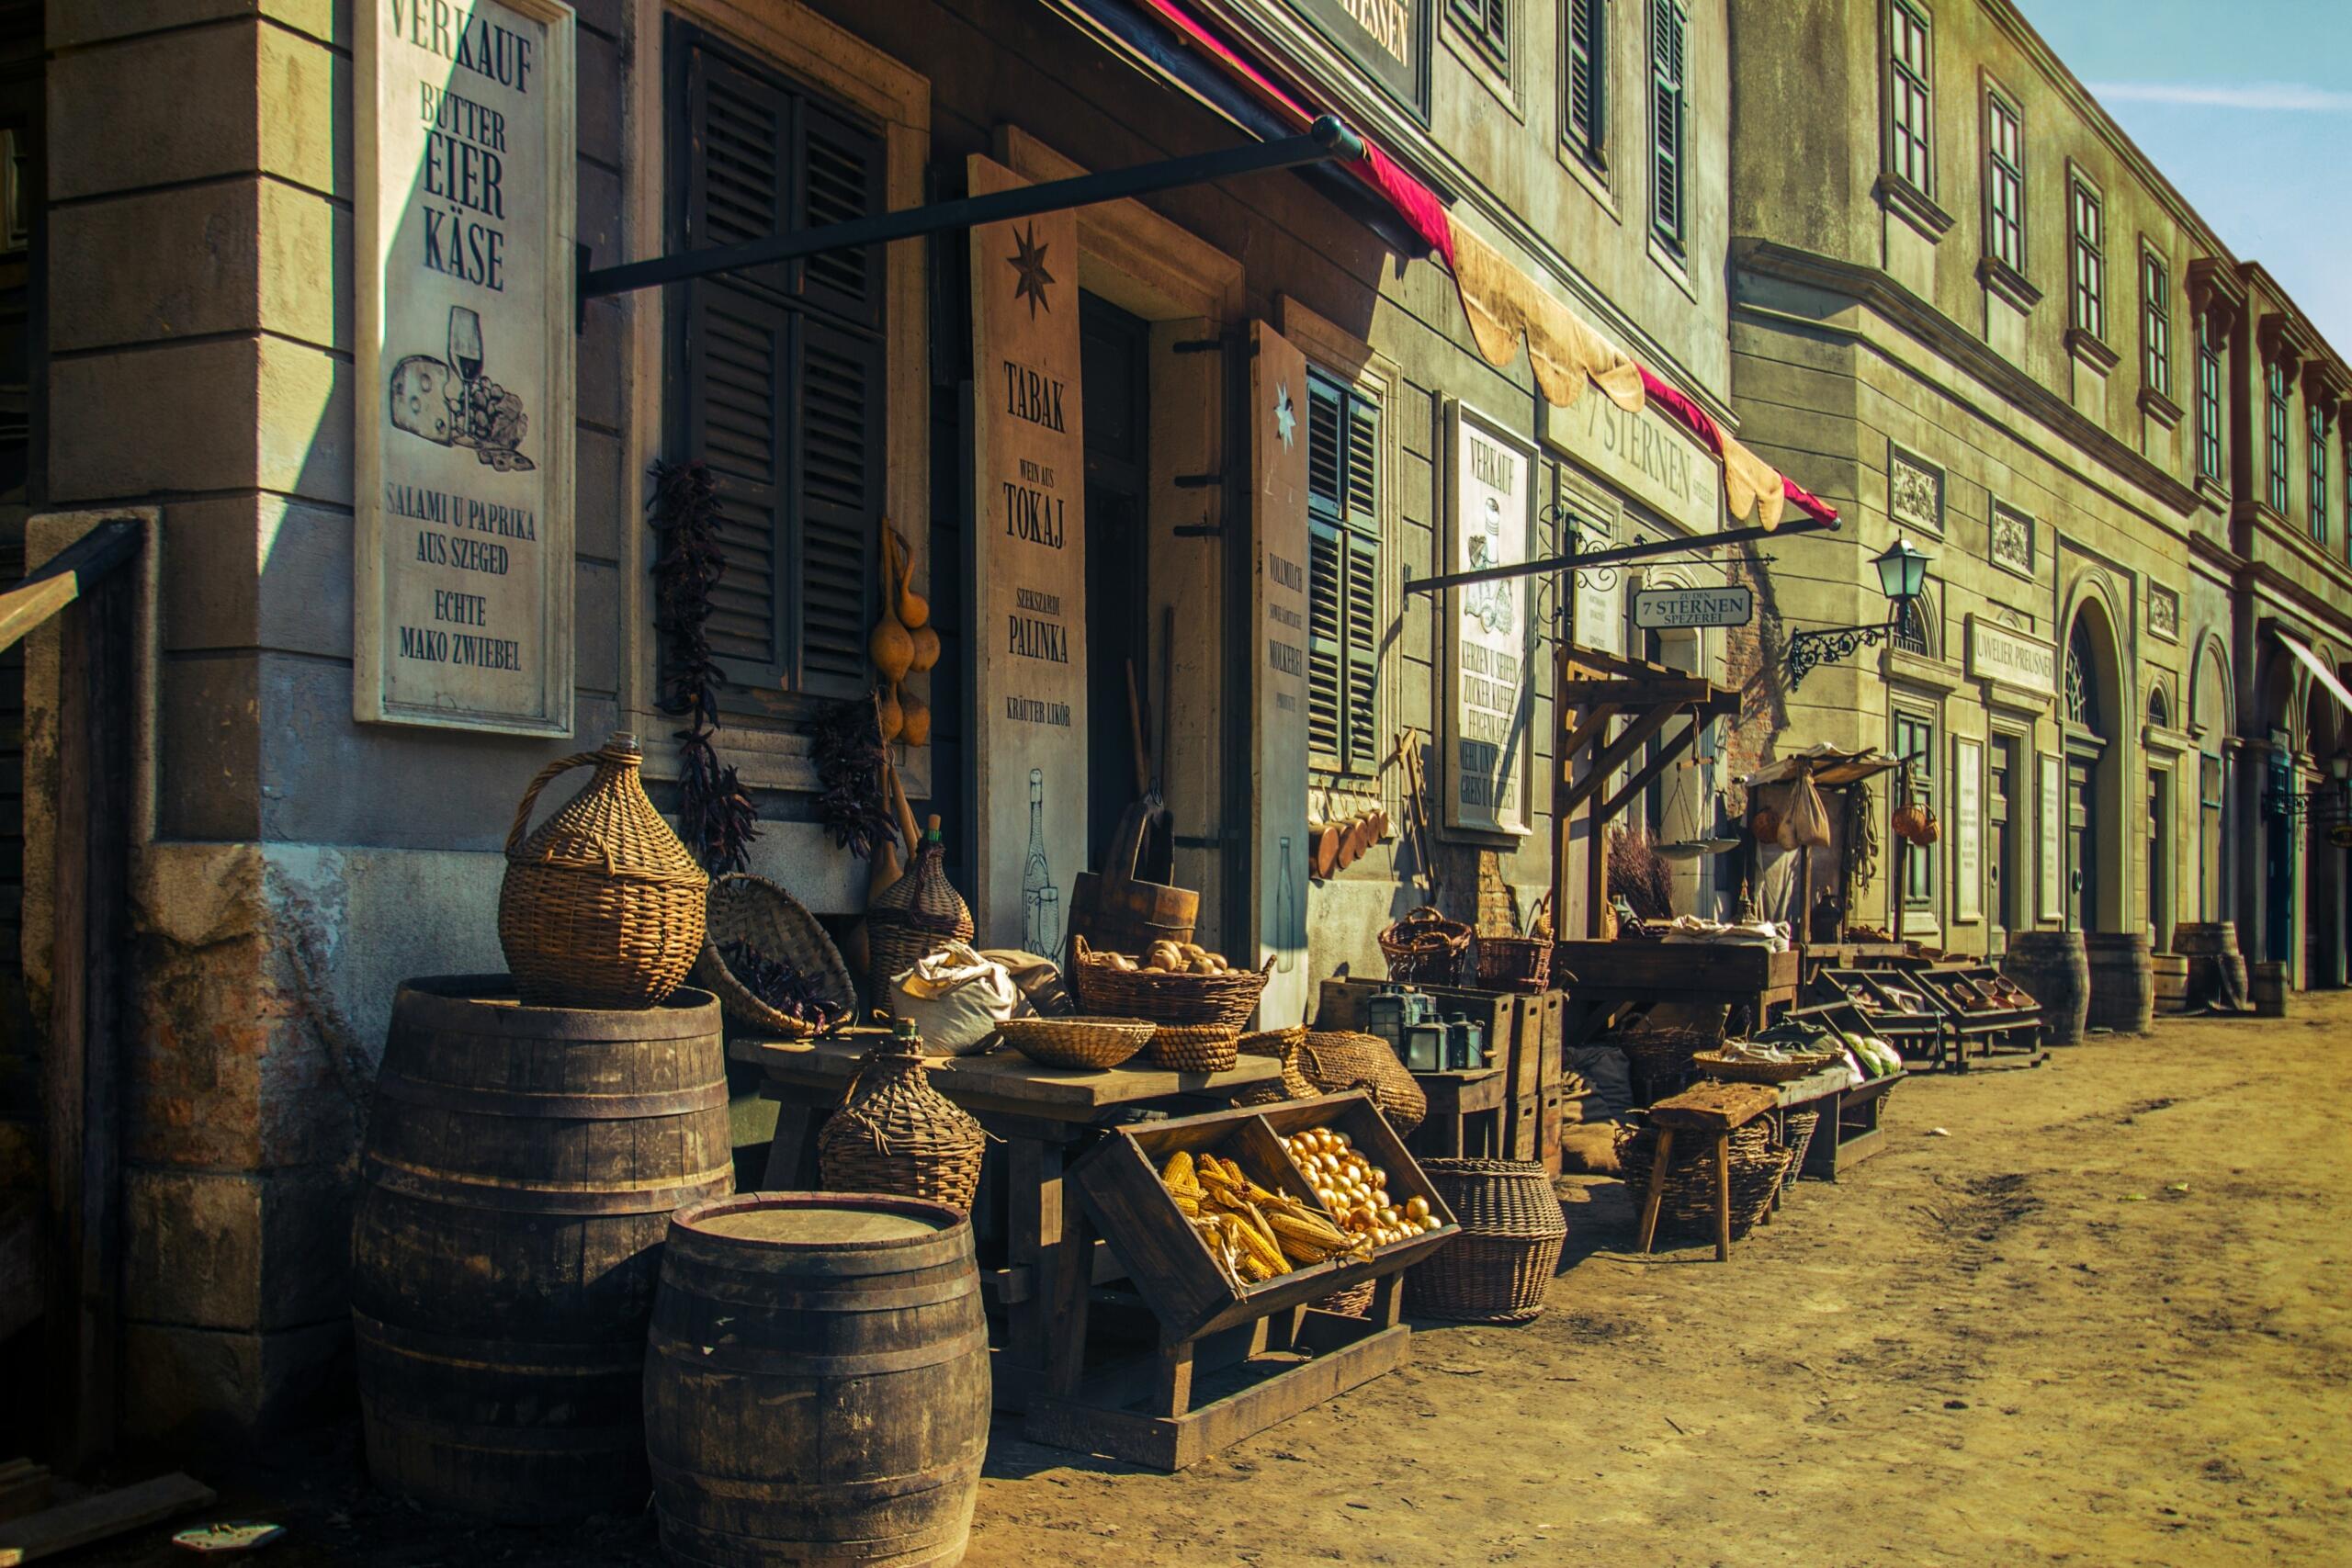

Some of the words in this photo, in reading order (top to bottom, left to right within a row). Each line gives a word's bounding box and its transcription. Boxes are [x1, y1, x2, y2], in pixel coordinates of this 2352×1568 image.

[390, 0, 532, 94] VERKAUF
[420, 81, 506, 153] BUTTER
[423, 128, 505, 220] EIER
[423, 205, 503, 292] KÄSE
[1003, 360, 1066, 434] TABAK
[1470, 436, 1513, 496] VERKAUF
[1603, 395, 1690, 504] STERNEN
[1019, 458, 1039, 483] WEIN
[1041, 464, 1055, 489] AUS
[387, 482, 447, 524] SALAMI
[453, 496, 464, 527] U
[469, 500, 536, 542] PAPRIKA
[1003, 481, 1064, 549] TOKAJ
[416, 531, 446, 566] AUS
[451, 537, 508, 575] SZEGED
[1269, 552, 1303, 594] VOLLMILCH
[435, 590, 486, 626] ECHTE
[1016, 587, 1060, 616] SZEKSZARDI
[1643, 603, 1652, 615] 7
[1656, 598, 1744, 615] STERNEN
[1664, 613, 1722, 625] SPEZEREI
[400, 626, 447, 661] MAKO
[453, 634, 521, 671] ZWIEBEL
[1009, 615, 1069, 664] PALINKA
[1269, 639, 1302, 677] MOLKEREI
[1462, 640, 1488, 675] KERZEN
[1497, 651, 1518, 684] SEIFEN
[1007, 695, 1046, 723] KRÄUTER
[1047, 701, 1070, 727] LIKÖR
[1464, 674, 1489, 708] ZUCKER
